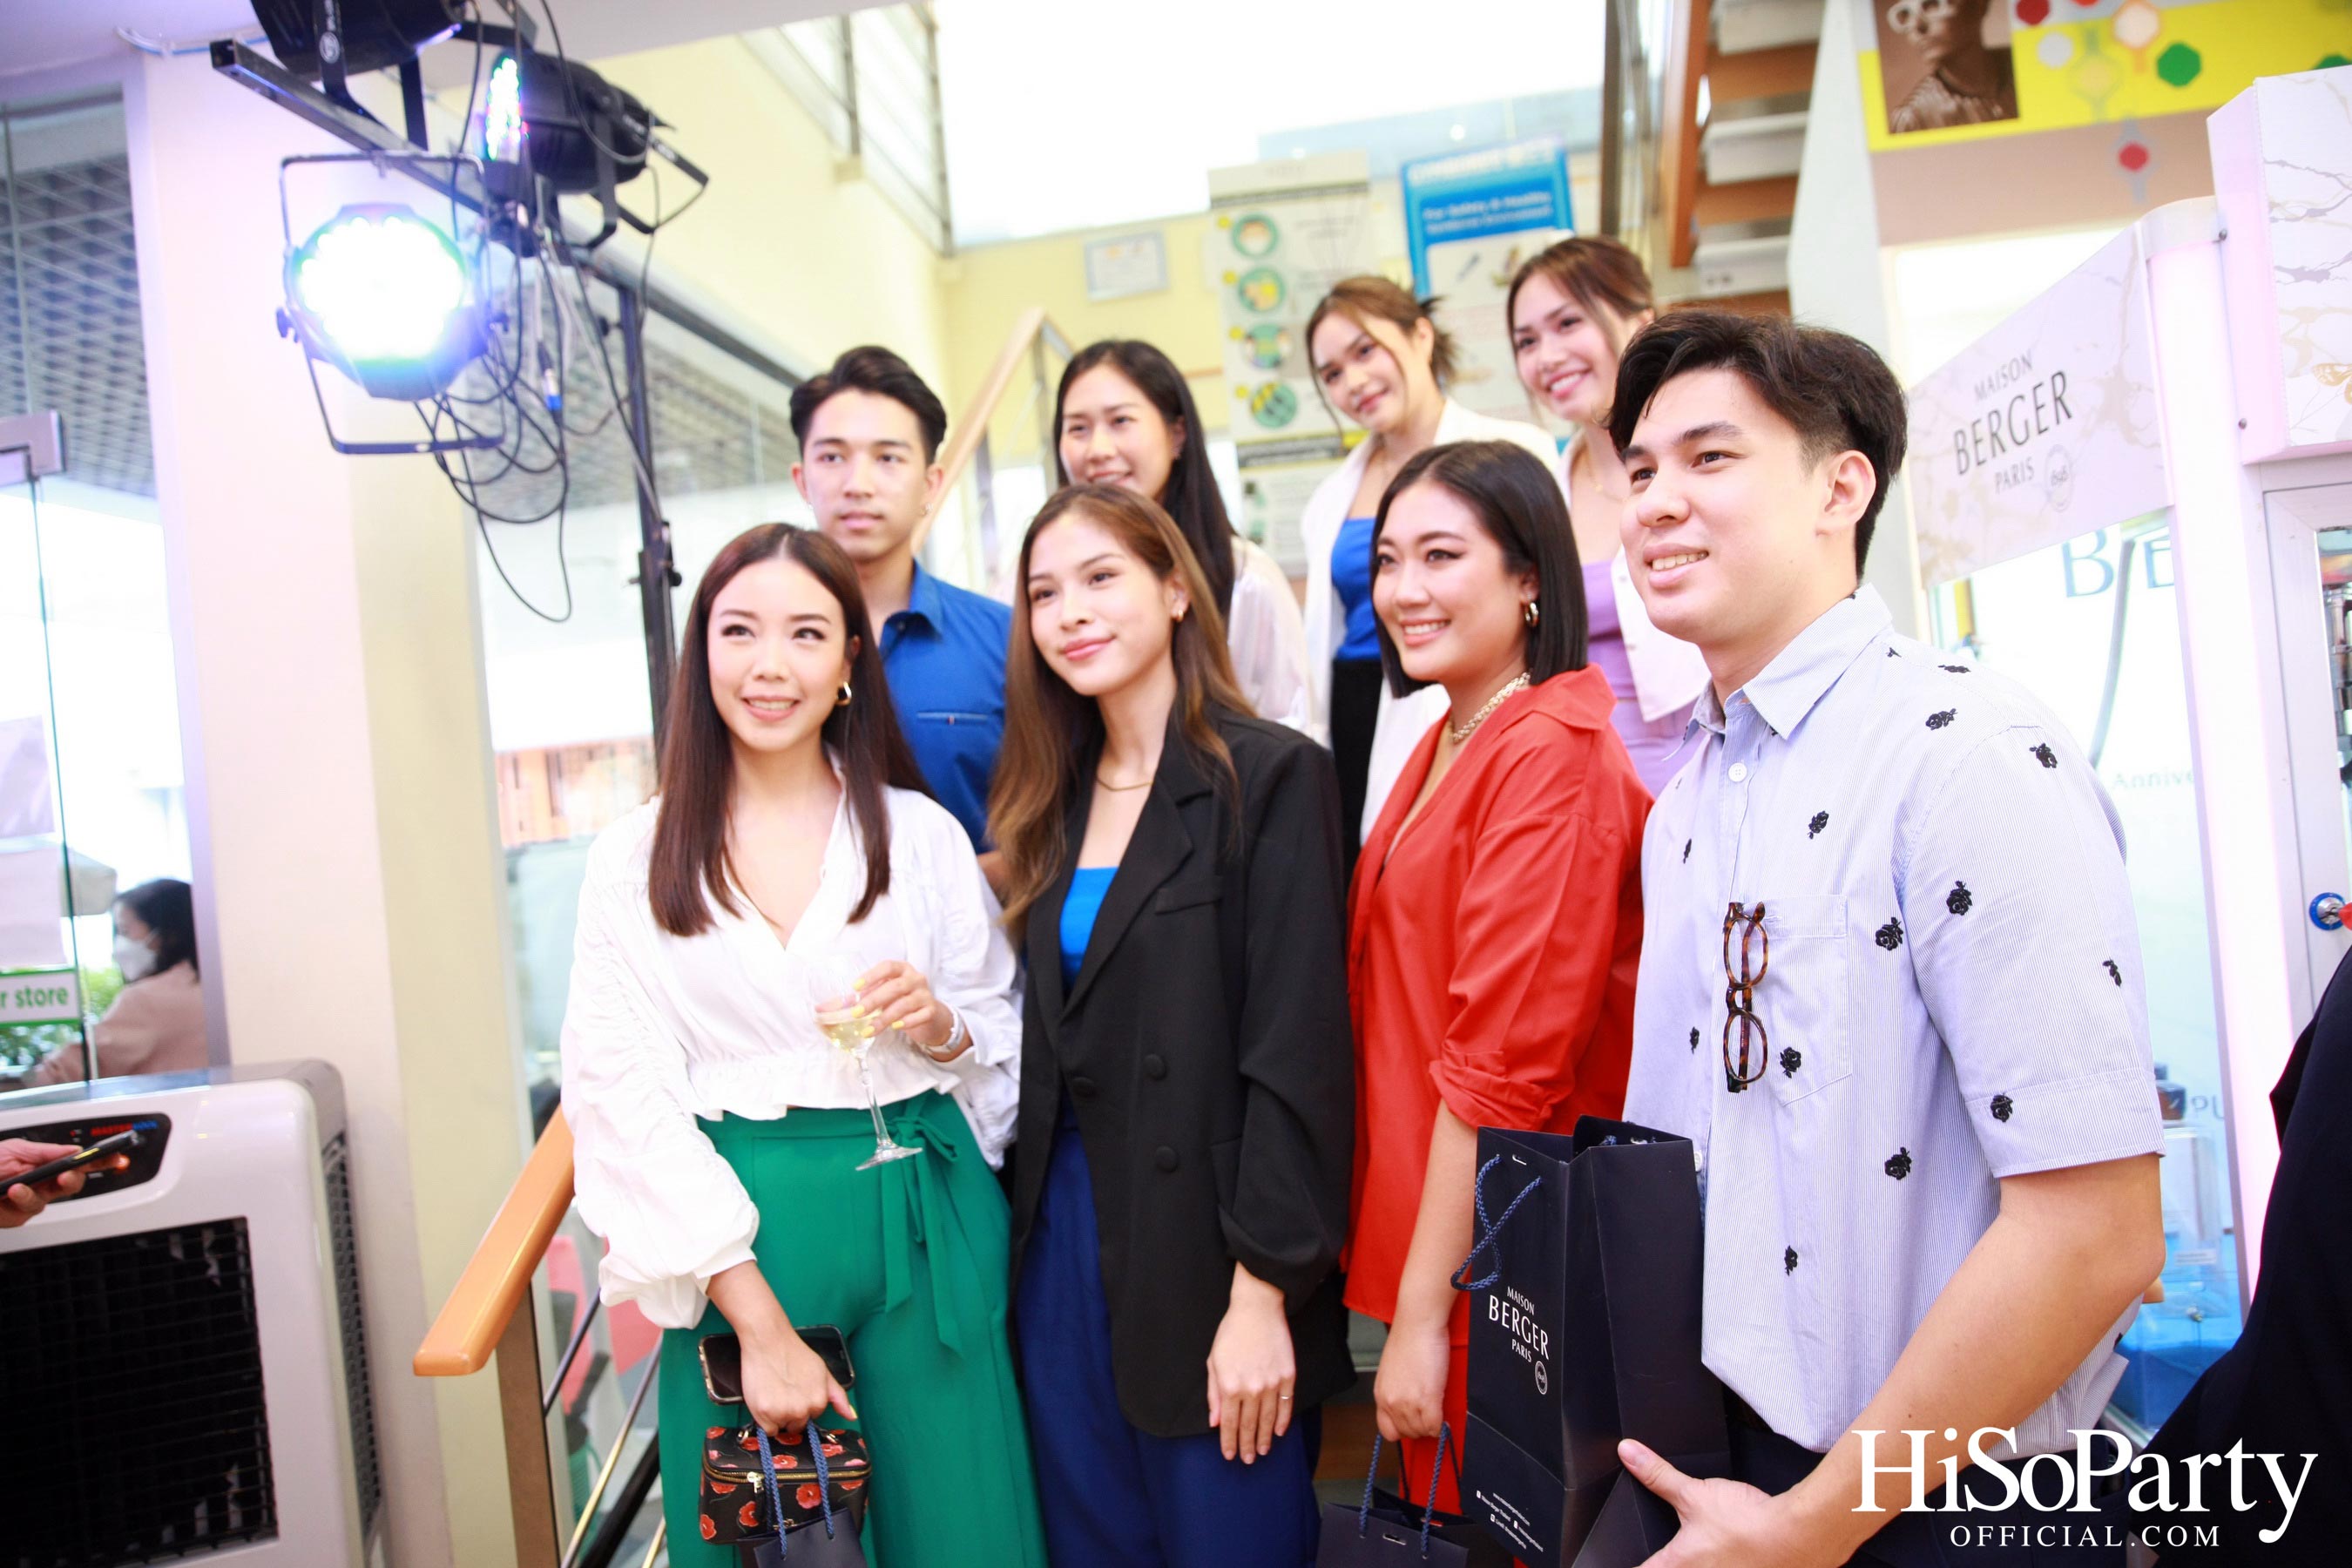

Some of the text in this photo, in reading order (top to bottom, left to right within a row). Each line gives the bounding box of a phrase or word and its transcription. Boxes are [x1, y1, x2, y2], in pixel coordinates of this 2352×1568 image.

[1974, 348, 2032, 403] MAISON
[1954, 369, 2072, 476] BERGER
[1995, 456, 2035, 494] PARIS
[15, 985, 69, 1009] store
[1507, 1286, 1534, 1315] MAISON
[1489, 1294, 1549, 1360] BERGER
[1511, 1339, 1531, 1362] PARIS
